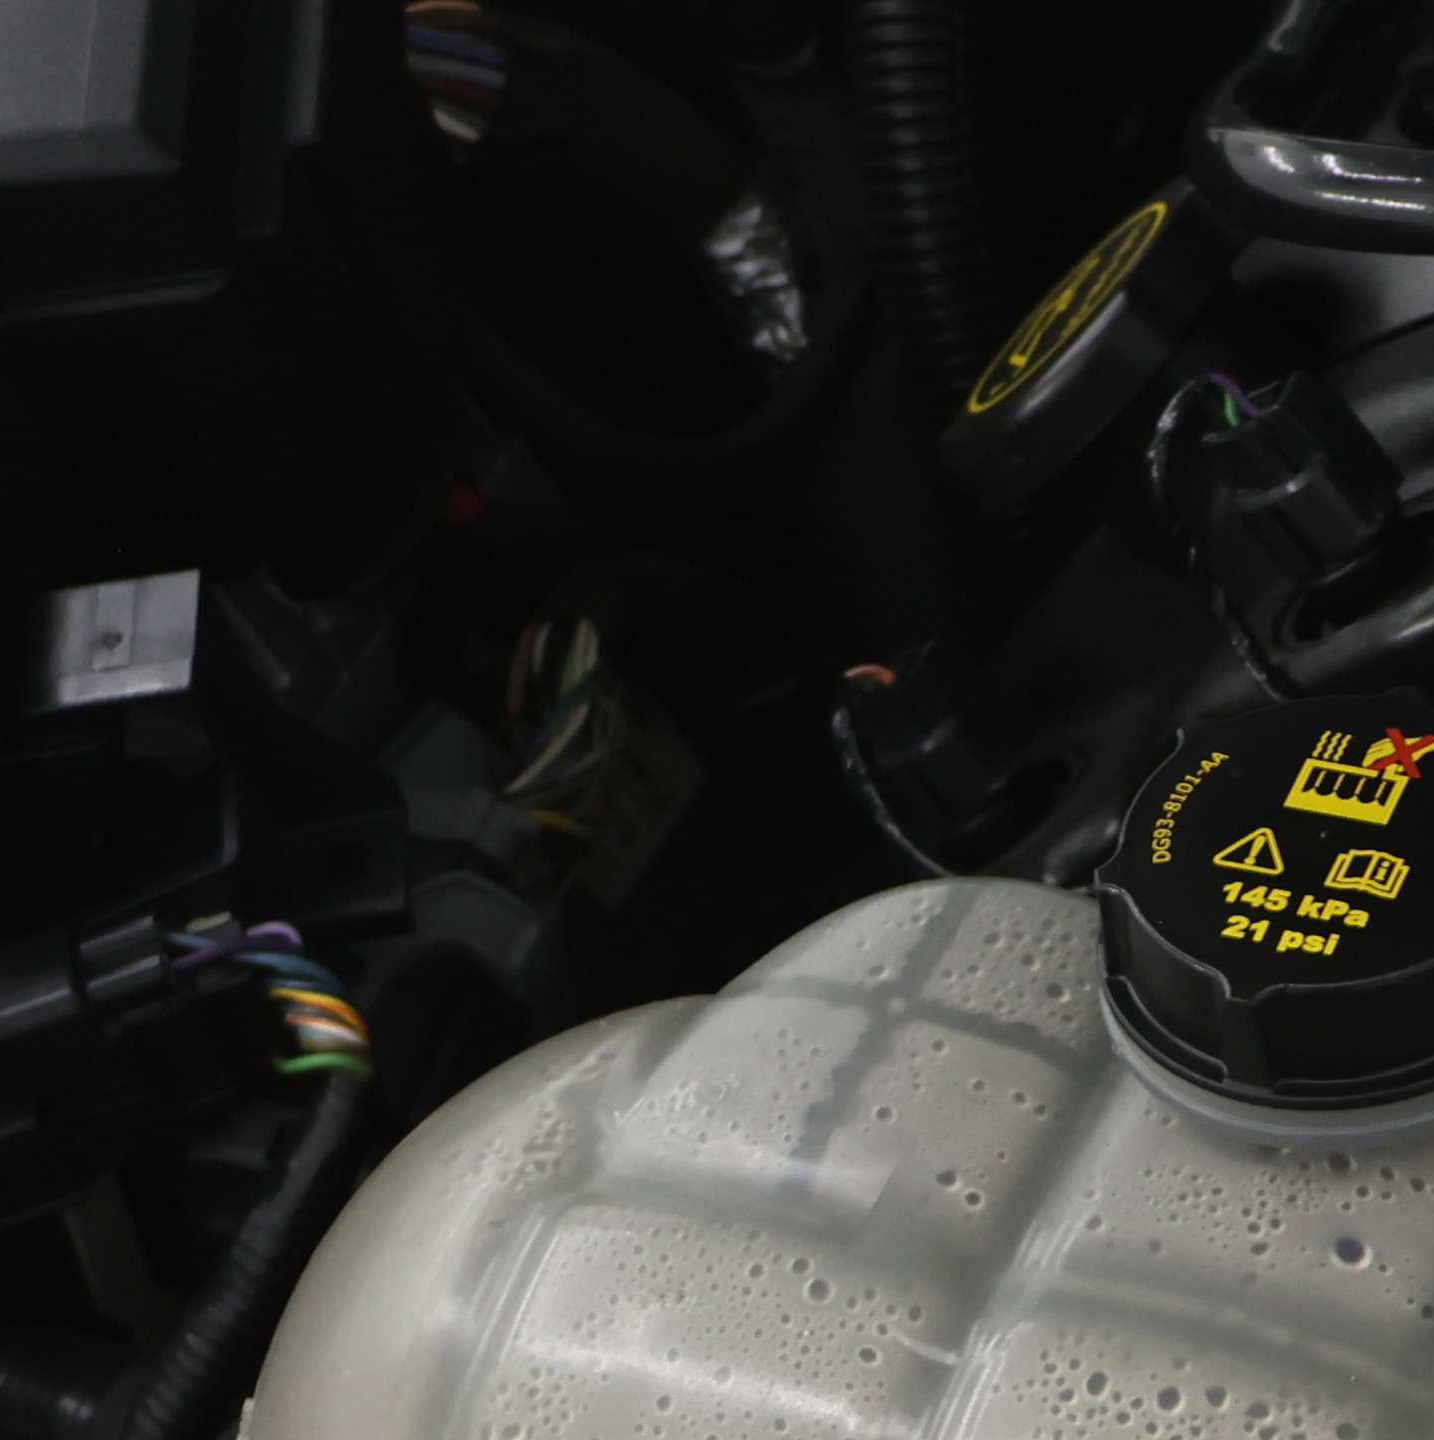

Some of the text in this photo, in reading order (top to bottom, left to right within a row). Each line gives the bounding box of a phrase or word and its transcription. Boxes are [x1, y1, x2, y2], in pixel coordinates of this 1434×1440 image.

[1151, 750, 1230, 864] DG93-8101-AA
[1221, 880, 1371, 929] 145 kPa
[1219, 914, 1342, 957] 21 psi
